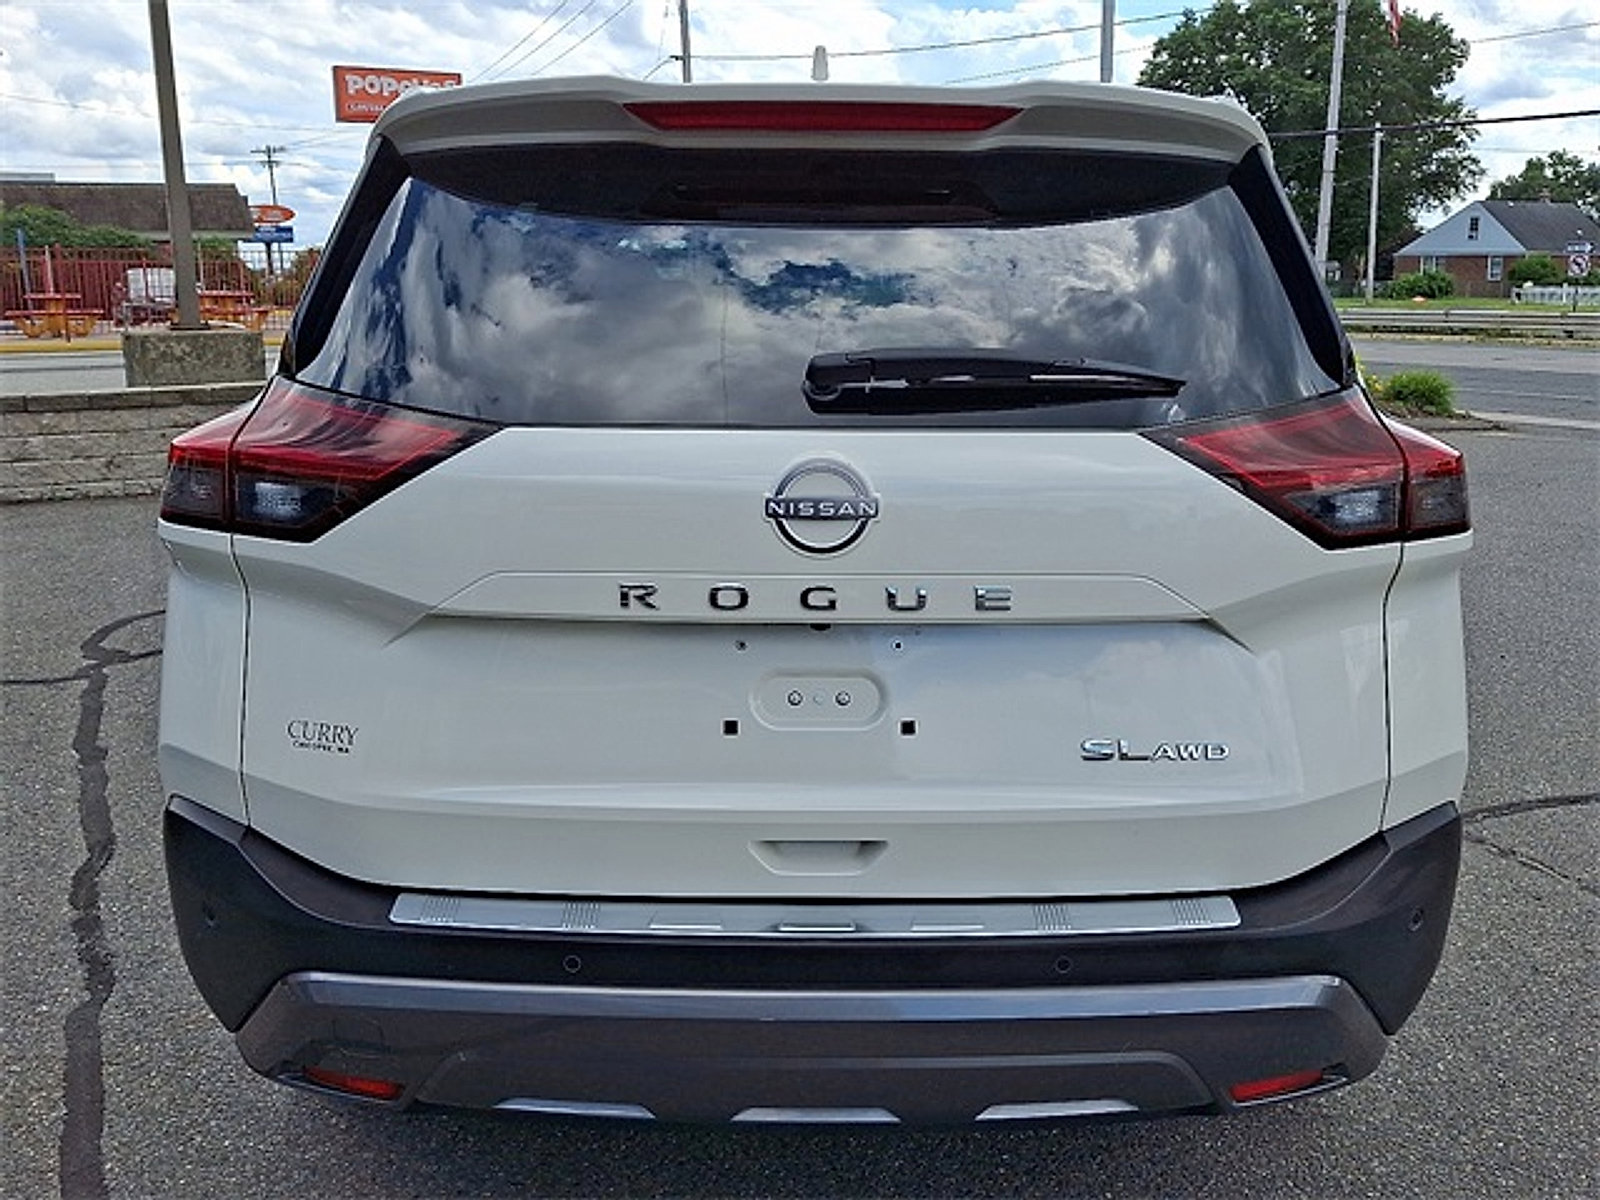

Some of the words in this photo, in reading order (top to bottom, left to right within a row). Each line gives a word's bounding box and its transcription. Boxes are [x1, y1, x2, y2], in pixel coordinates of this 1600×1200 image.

[767, 501, 877, 517] NISSAN
[618, 584, 1013, 612] ROGUE
[287, 719, 359, 746] CURRY
